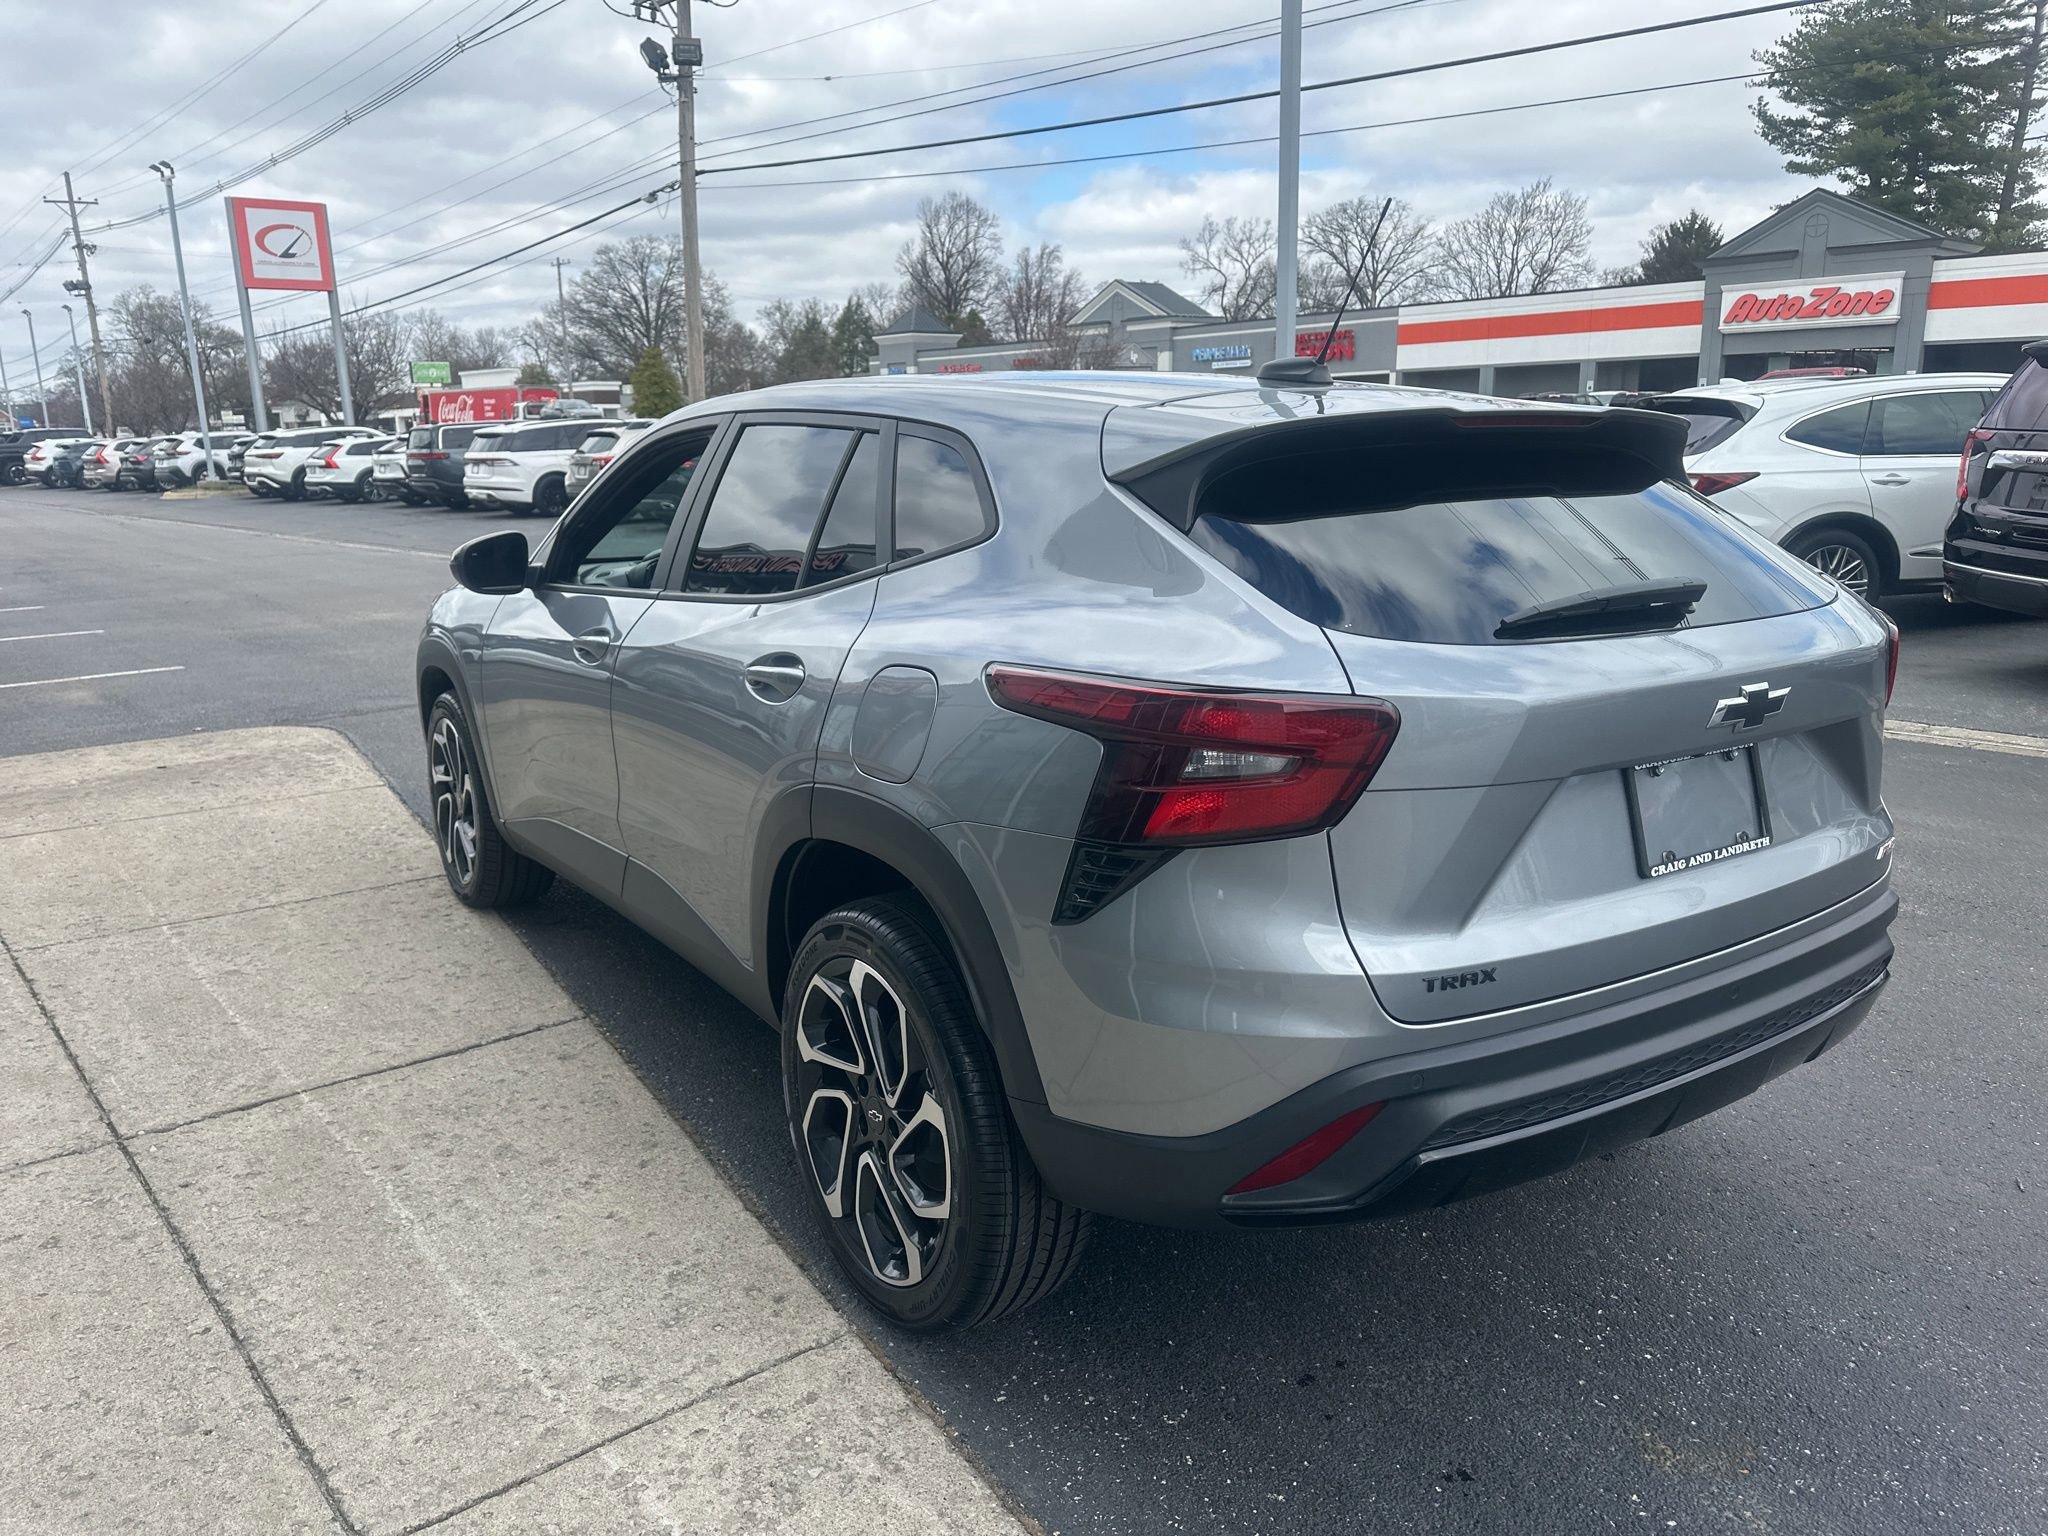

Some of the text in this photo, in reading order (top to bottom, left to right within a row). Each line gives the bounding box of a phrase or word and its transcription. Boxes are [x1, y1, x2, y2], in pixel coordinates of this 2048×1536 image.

[1723, 286, 1895, 324] AutoZone
[2026, 456, 2048, 464] GM
[1650, 836, 1771, 877] CRAIG AND LANDRETH
[1422, 967, 1497, 993] TRAX
